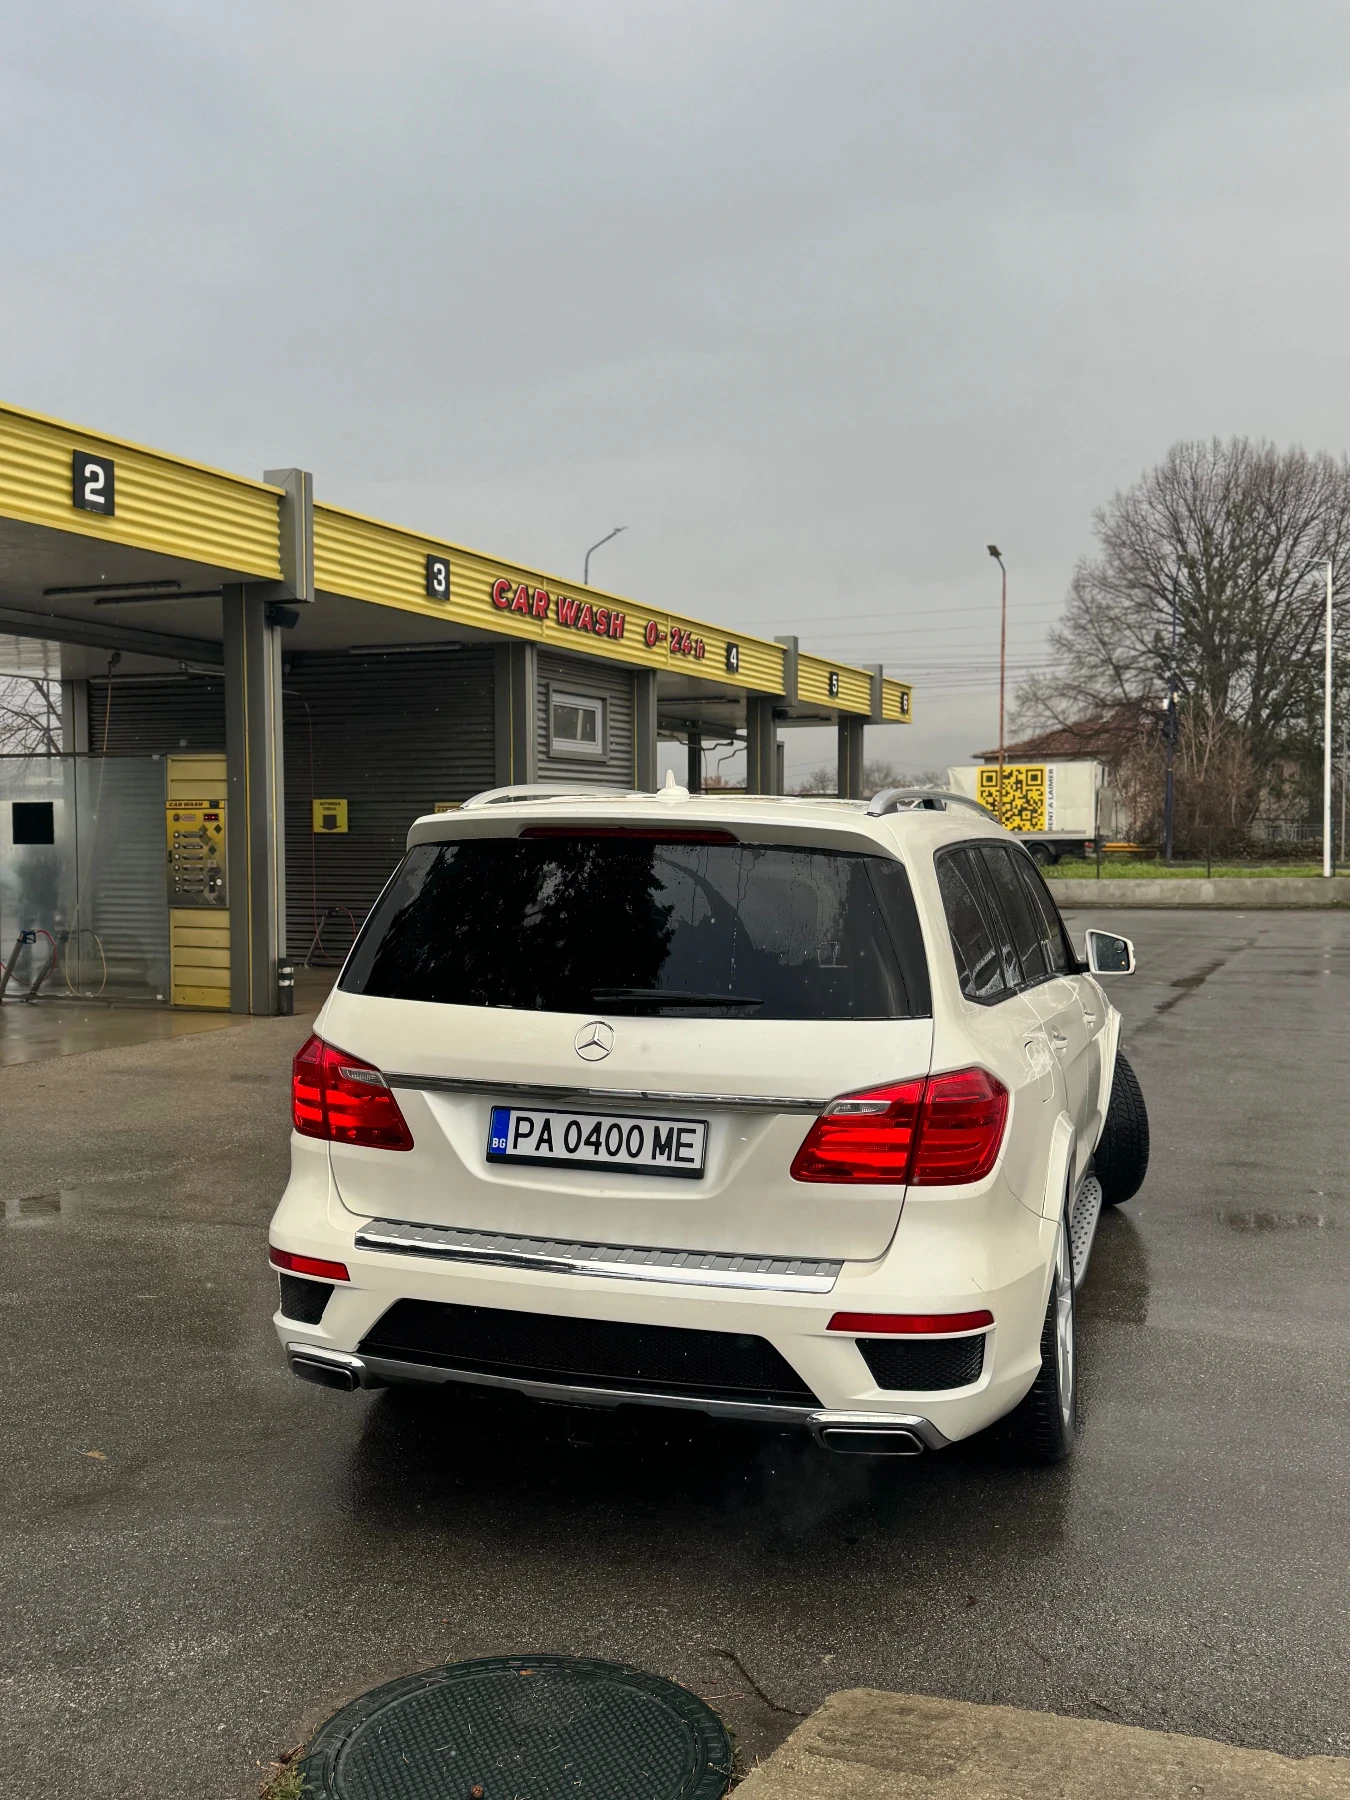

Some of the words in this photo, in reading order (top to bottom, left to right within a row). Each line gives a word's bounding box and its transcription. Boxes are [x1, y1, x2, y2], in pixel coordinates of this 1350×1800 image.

[84, 463, 105, 504] 2
[433, 562, 446, 592] 3
[493, 578, 549, 618] CAR
[556, 595, 626, 639] WASH
[730, 647, 738, 667] 4
[832, 675, 838, 692] 5
[903, 695, 908, 710] 6
[492, 1138, 507, 1149] BG
[512, 1116, 554, 1153] PA
[563, 1119, 645, 1158] 0400
[651, 1125, 697, 1164] ME
